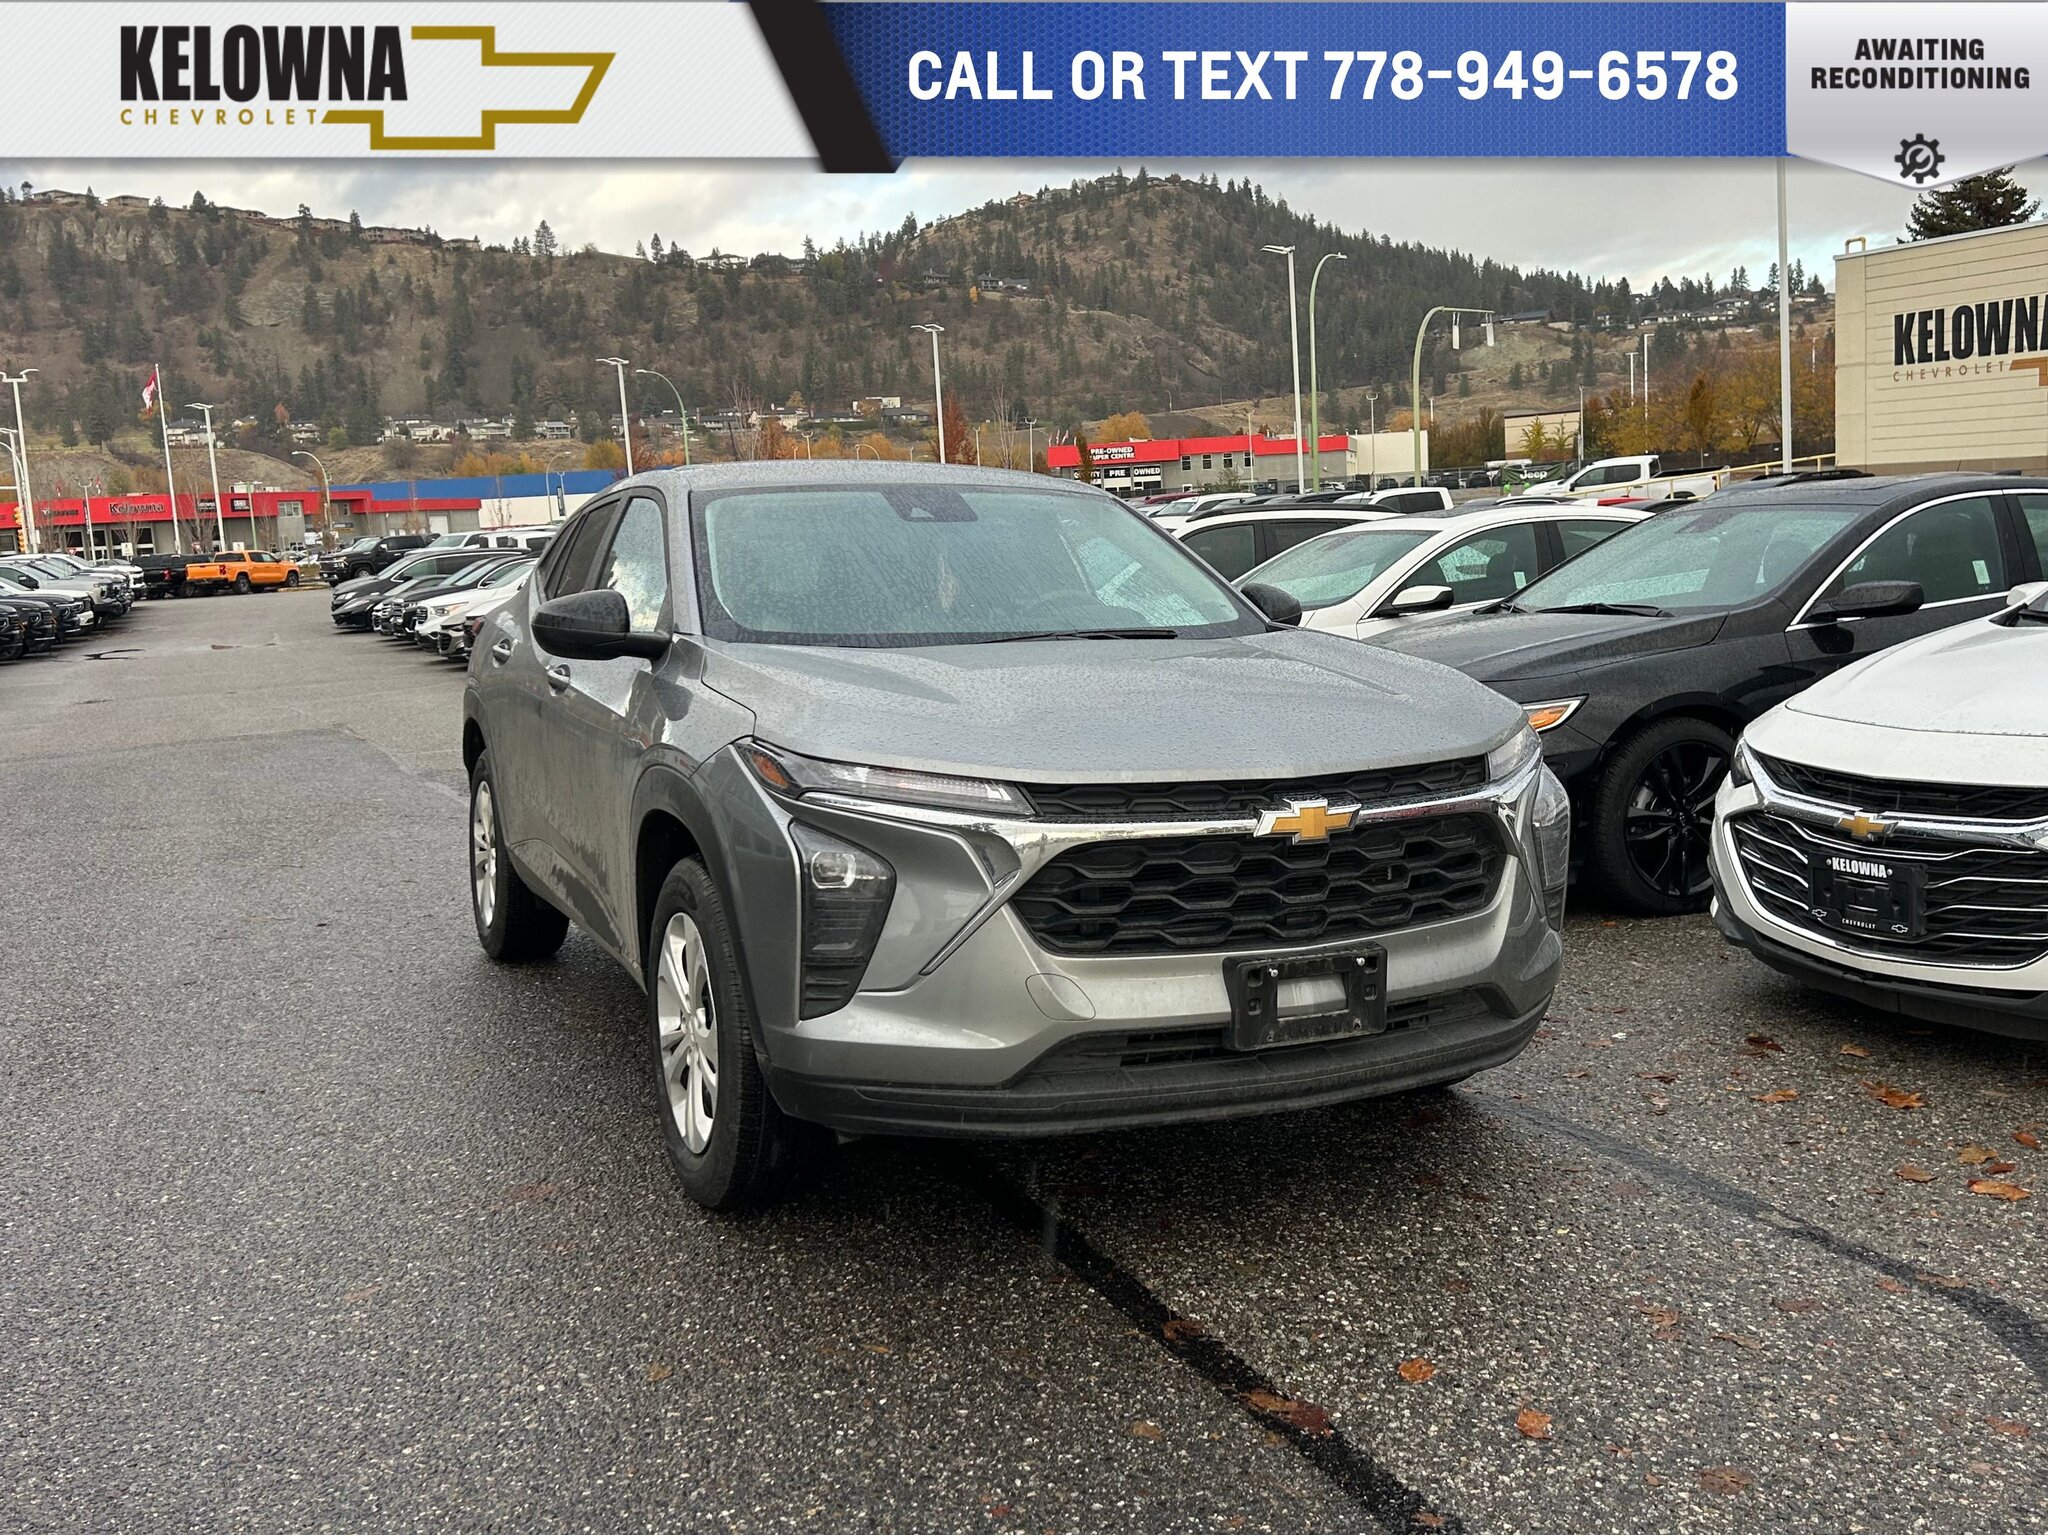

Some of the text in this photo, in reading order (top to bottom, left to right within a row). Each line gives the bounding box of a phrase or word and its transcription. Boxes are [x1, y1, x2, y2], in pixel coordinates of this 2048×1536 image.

[1893, 361, 2005, 383] CHEVROLET
[1109, 469, 1125, 477] PRE
[1134, 467, 1160, 475] OWNED
[1520, 470, 1548, 479] Jeep
[109, 502, 164, 515] Kelowna
[1832, 857, 1887, 878] KELOWNA
[1842, 918, 1876, 929] CHEVROLET
